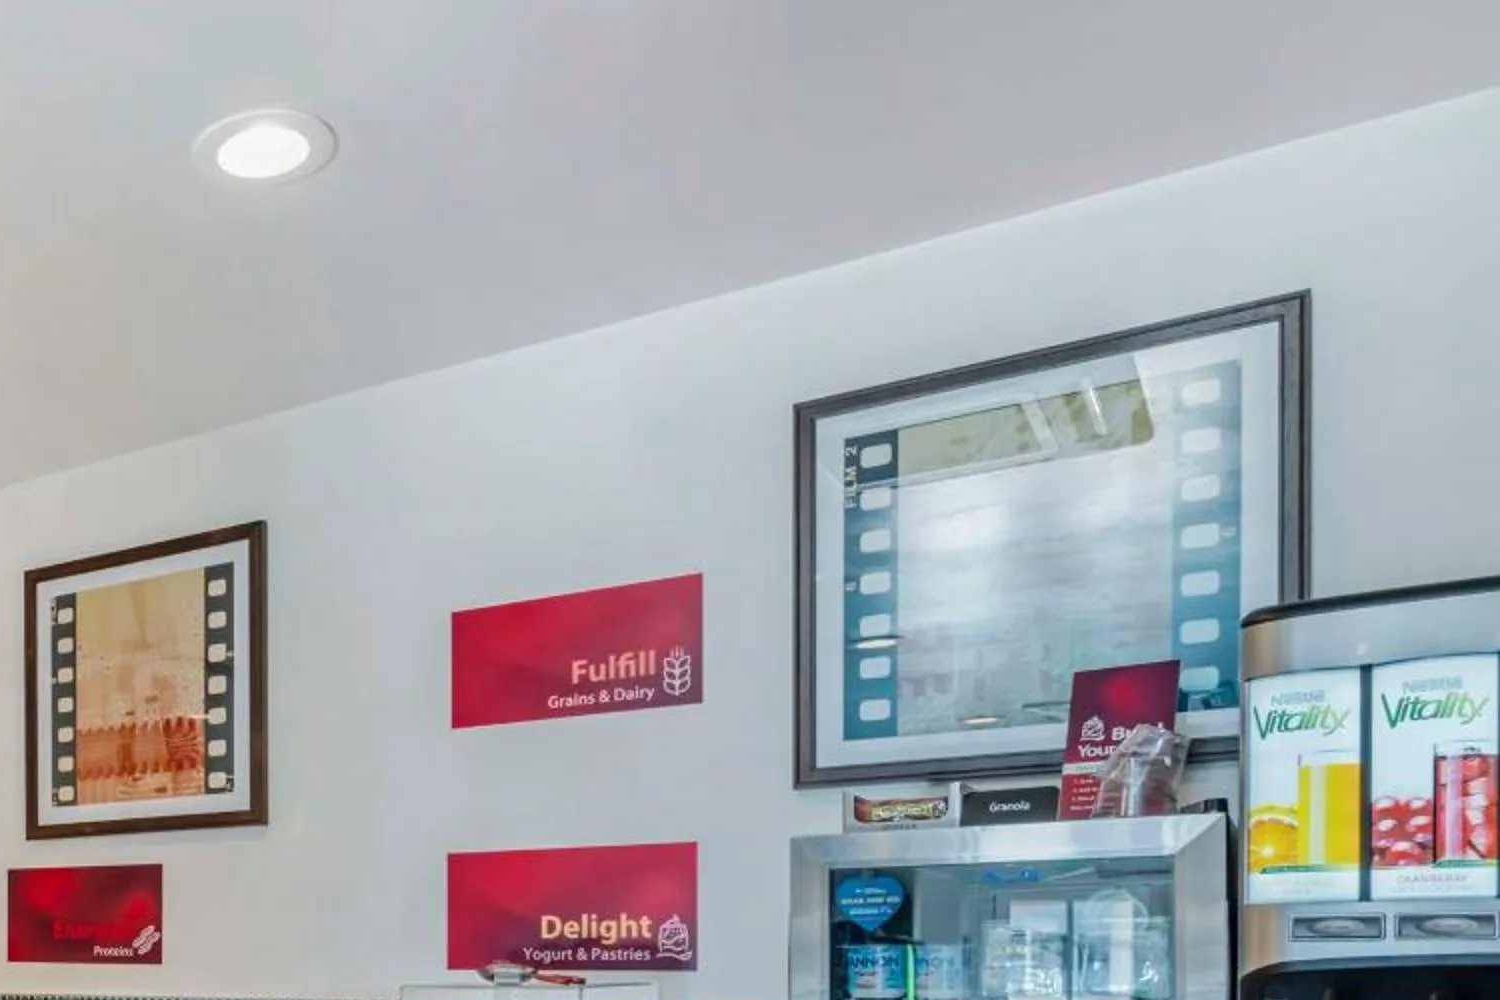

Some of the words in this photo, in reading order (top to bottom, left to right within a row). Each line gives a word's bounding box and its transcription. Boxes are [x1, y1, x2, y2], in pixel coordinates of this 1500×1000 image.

[571, 650, 656, 684] Fulfill
[547, 694, 596, 709] Grains
[599, 689, 612, 703] &
[613, 685, 655, 701] Dairy
[1381, 691, 1489, 729] Vitality
[1253, 703, 1350, 740] Vitality
[989, 800, 1031, 813] Granola
[541, 913, 652, 945] Delight
[93, 945, 134, 957] Proteins
[523, 947, 573, 964] Yogurt
[576, 949, 589, 961] &
[591, 948, 651, 961] Pastries
